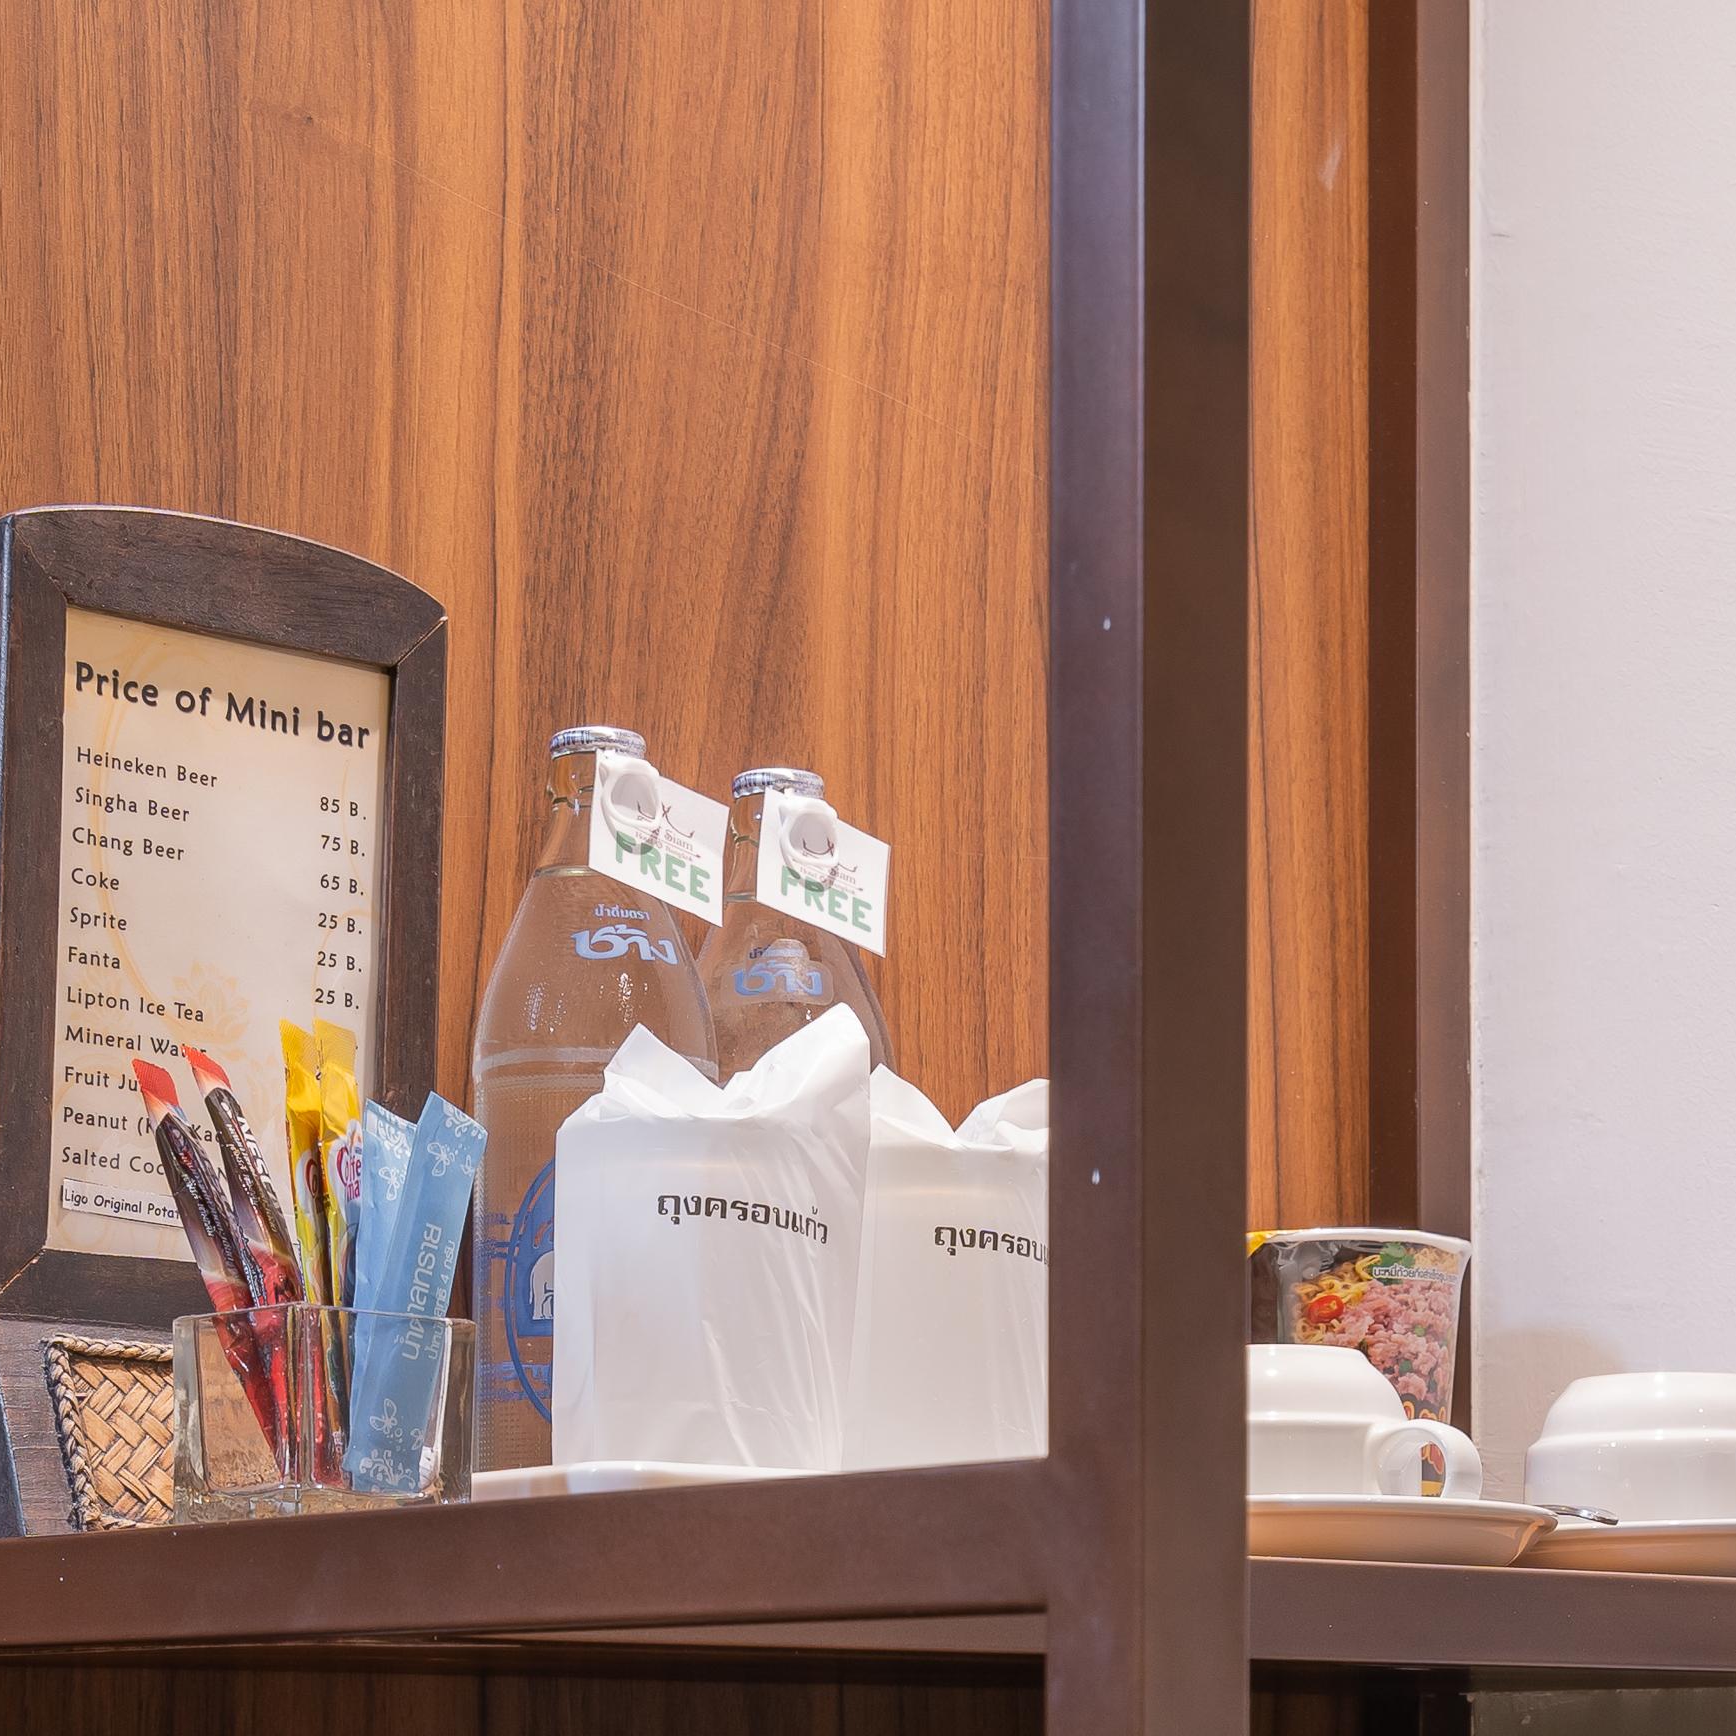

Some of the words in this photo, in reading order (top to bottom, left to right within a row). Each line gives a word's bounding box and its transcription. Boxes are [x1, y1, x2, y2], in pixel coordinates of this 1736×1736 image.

[75, 661, 159, 707] Price
[175, 687, 212, 716] of
[225, 692, 300, 736] Mini
[317, 711, 370, 749] bar
[76, 746, 167, 779] Heineken
[177, 765, 218, 788] Beer
[75, 787, 138, 814] Singha
[148, 799, 190, 822] Beer
[320, 797, 340, 814] 85
[72, 827, 133, 856] Chang
[143, 838, 185, 861] Beer
[320, 835, 341, 852] 75
[350, 840, 365, 858] B.
[71, 867, 120, 891] Coke
[320, 874, 340, 891] 65
[348, 878, 364, 896] B.
[615, 830, 710, 904] FREE
[780, 864, 872, 933] FREE
[69, 907, 127, 931] Sprite
[318, 912, 338, 930] 25
[346, 917, 362, 935] B.
[67, 946, 121, 970] Fanta
[317, 951, 337, 968] 25
[346, 956, 362, 973] B.
[66, 986, 129, 1011] Lipton
[139, 997, 165, 1017] Ice
[174, 1002, 204, 1022] Tea
[315, 988, 335, 1005] 25
[344, 992, 360, 1010] B.
[65, 1025, 141, 1051] Mineral
[64, 1066, 110, 1088] Fruit
[63, 1106, 128, 1131] Peanut
[62, 1147, 120, 1170] Salted
[64, 1189, 88, 1207] Ligo
[94, 1195, 142, 1214] Original
[656, 1194, 829, 1244] ถุงครอบแก้ว
